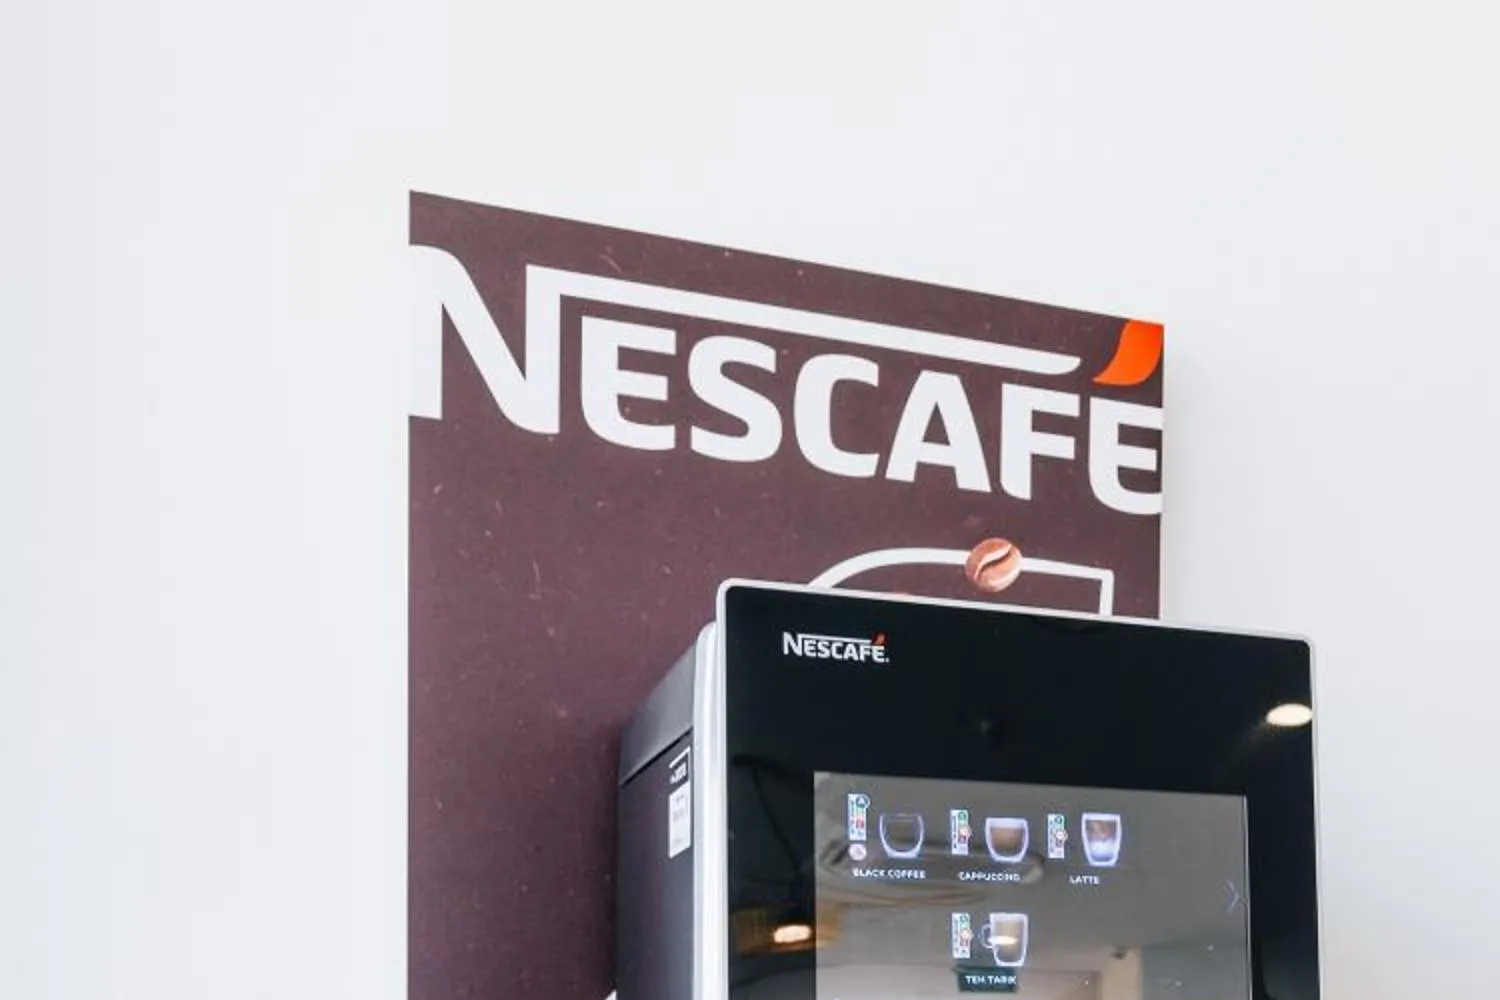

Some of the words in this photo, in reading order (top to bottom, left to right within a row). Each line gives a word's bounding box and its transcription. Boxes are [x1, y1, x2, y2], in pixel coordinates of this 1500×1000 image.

[408, 243, 1164, 516] NESCAFÉ
[783, 631, 890, 663] NESCAFÉ
[852, 868, 885, 878] BLACK
[888, 869, 927, 879] COFFEE
[1069, 875, 1101, 885] LATTE
